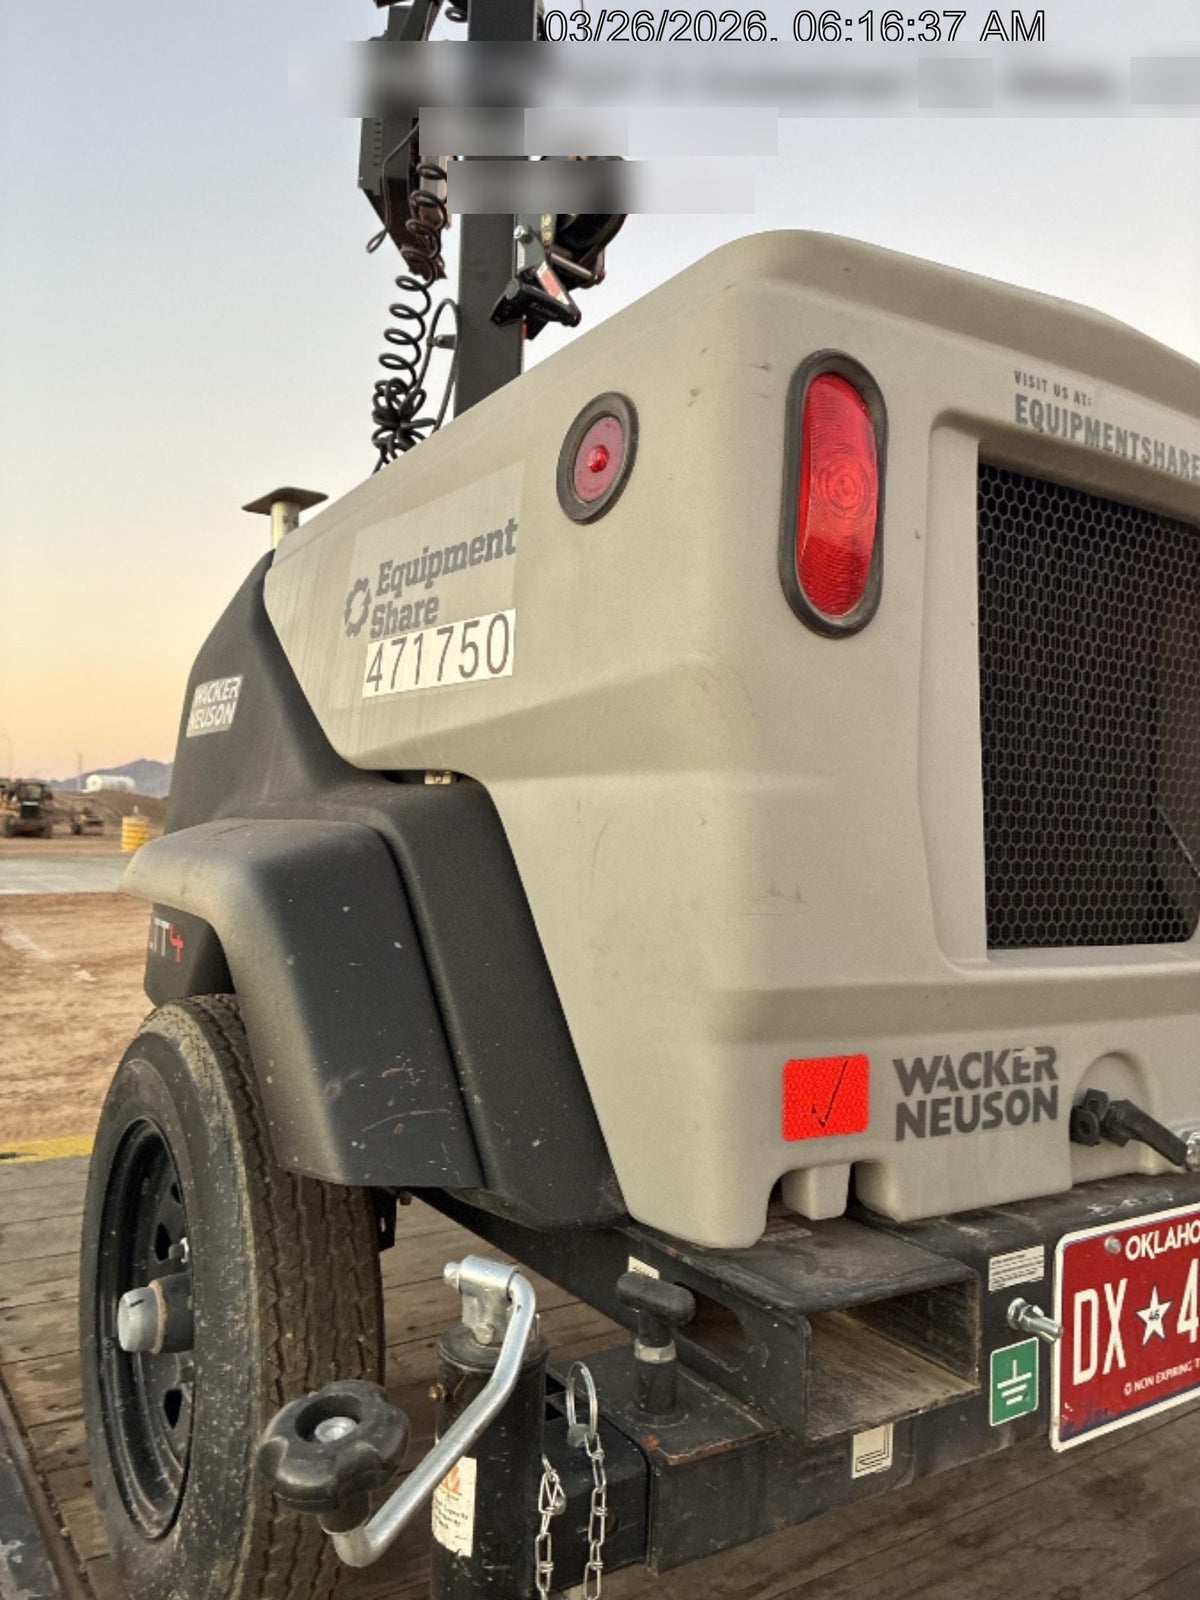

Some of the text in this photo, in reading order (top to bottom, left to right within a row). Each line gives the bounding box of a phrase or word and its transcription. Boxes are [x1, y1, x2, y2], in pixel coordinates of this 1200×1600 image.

[1014, 370, 1048, 393] VISIT
[1053, 383, 1069, 399] US
[1014, 393, 1200, 480] EQUIPMENTSHARE
[375, 518, 518, 598] Equipment
[369, 596, 440, 639] Share
[365, 613, 510, 692] 471750
[149, 917, 185, 963] TT4
[893, 1046, 1059, 1097] WACKER
[896, 1085, 1058, 1142] NEUSON
[1072, 1258, 1199, 1387] DX 4
[1134, 1375, 1155, 1392] NON
[1155, 1360, 1192, 1384] EXPIRING
